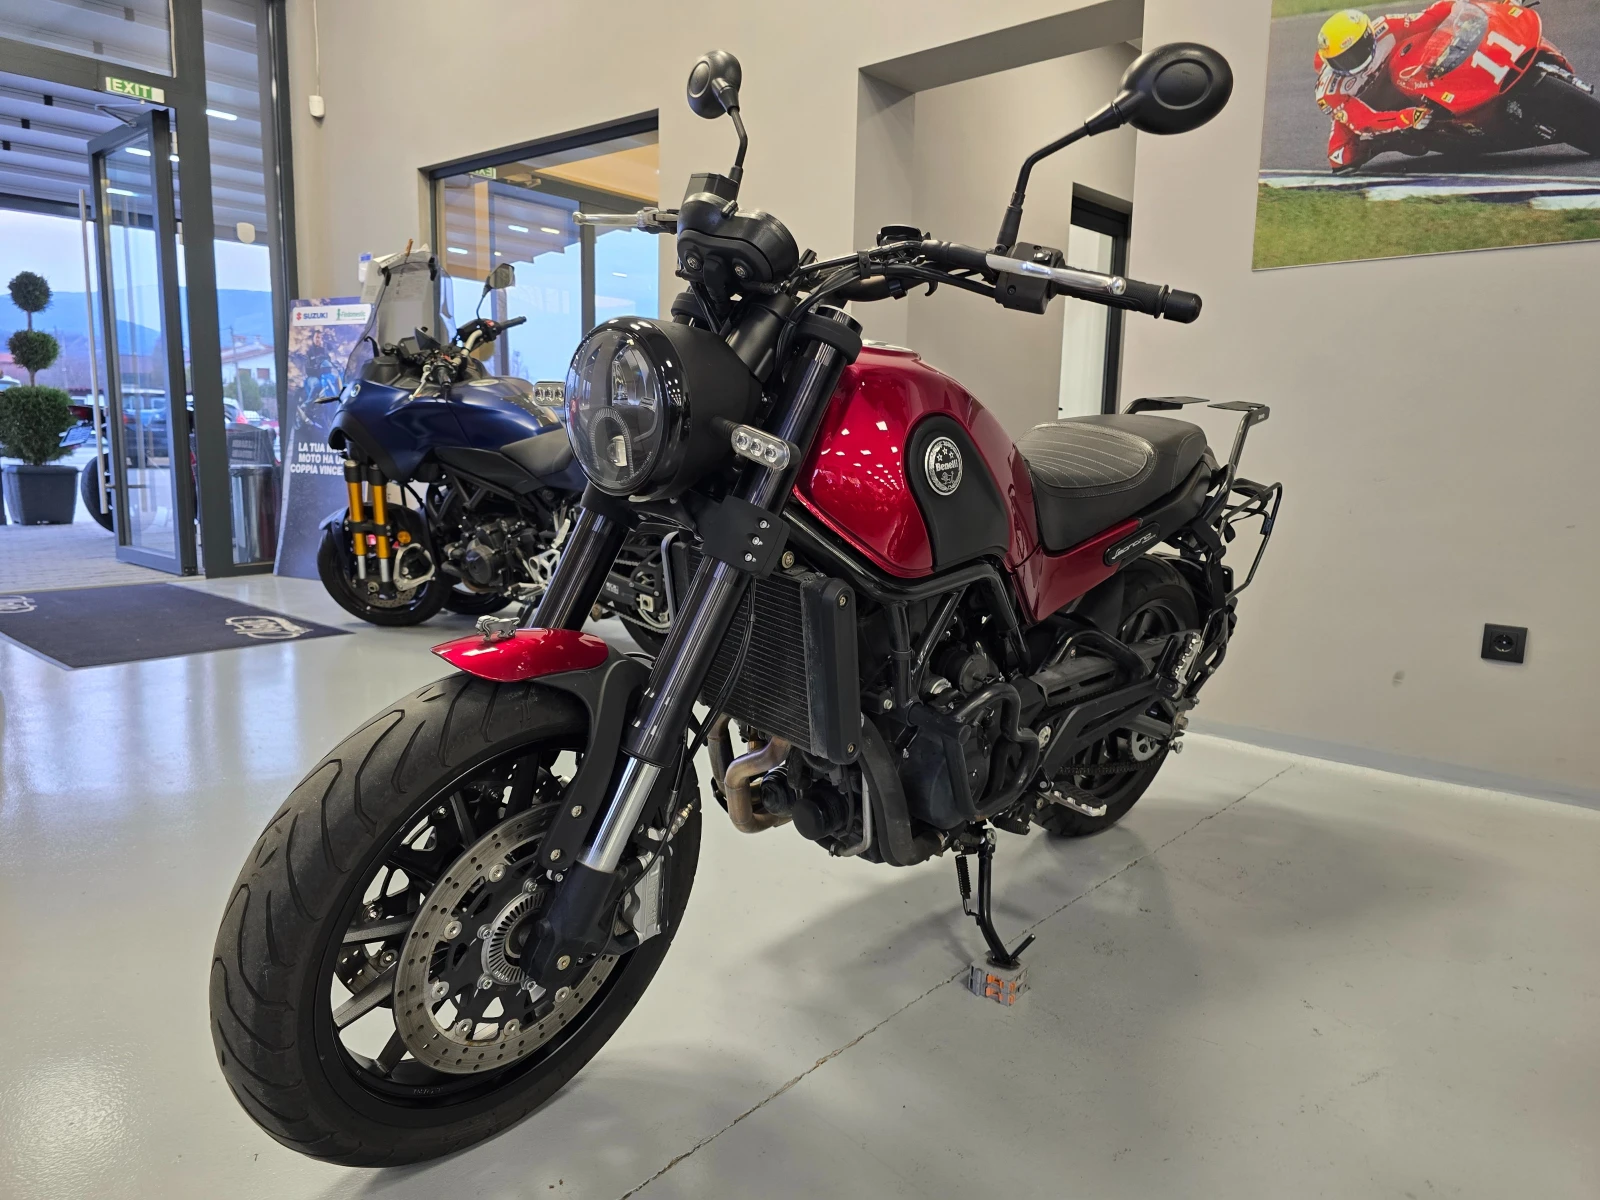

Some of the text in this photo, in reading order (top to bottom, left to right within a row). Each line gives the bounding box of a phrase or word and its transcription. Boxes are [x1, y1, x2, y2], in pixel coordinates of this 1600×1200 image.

[1471, 31, 1526, 85] 11
[112, 78, 150, 98] EXIT
[303, 312, 328, 320] SUZUKI
[298, 442, 309, 452] LA
[310, 442, 325, 453] TUA
[298, 453, 322, 464] MOTO
[323, 454, 334, 464] HA
[290, 464, 345, 476] COPPIA VINCE
